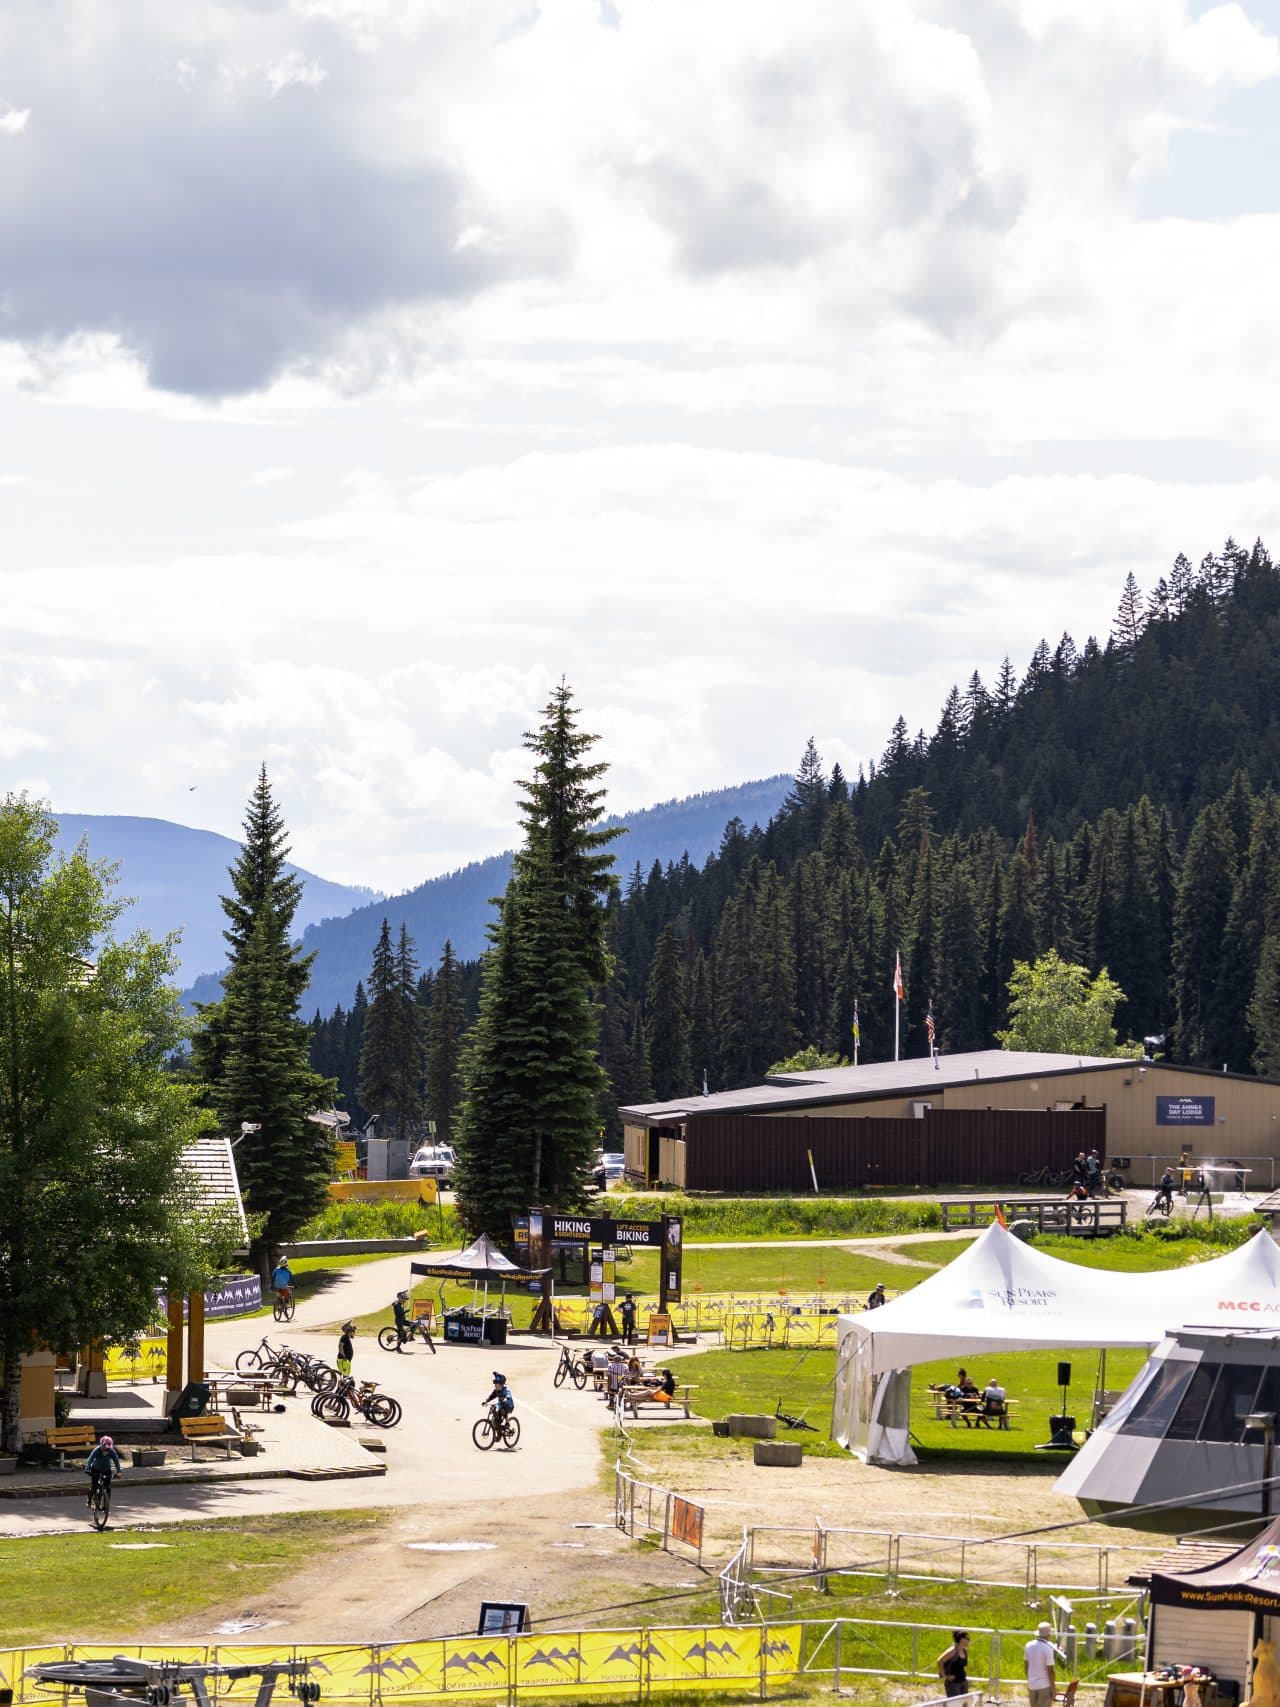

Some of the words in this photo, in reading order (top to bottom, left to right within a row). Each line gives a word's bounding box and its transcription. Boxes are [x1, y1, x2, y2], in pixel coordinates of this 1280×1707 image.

[554, 1220, 591, 1233] HIKING
[616, 1231, 649, 1241] BIKING
[1218, 1301, 1261, 1311] MCC
[1181, 1591, 1280, 1608] www.SunPeaksResort.
